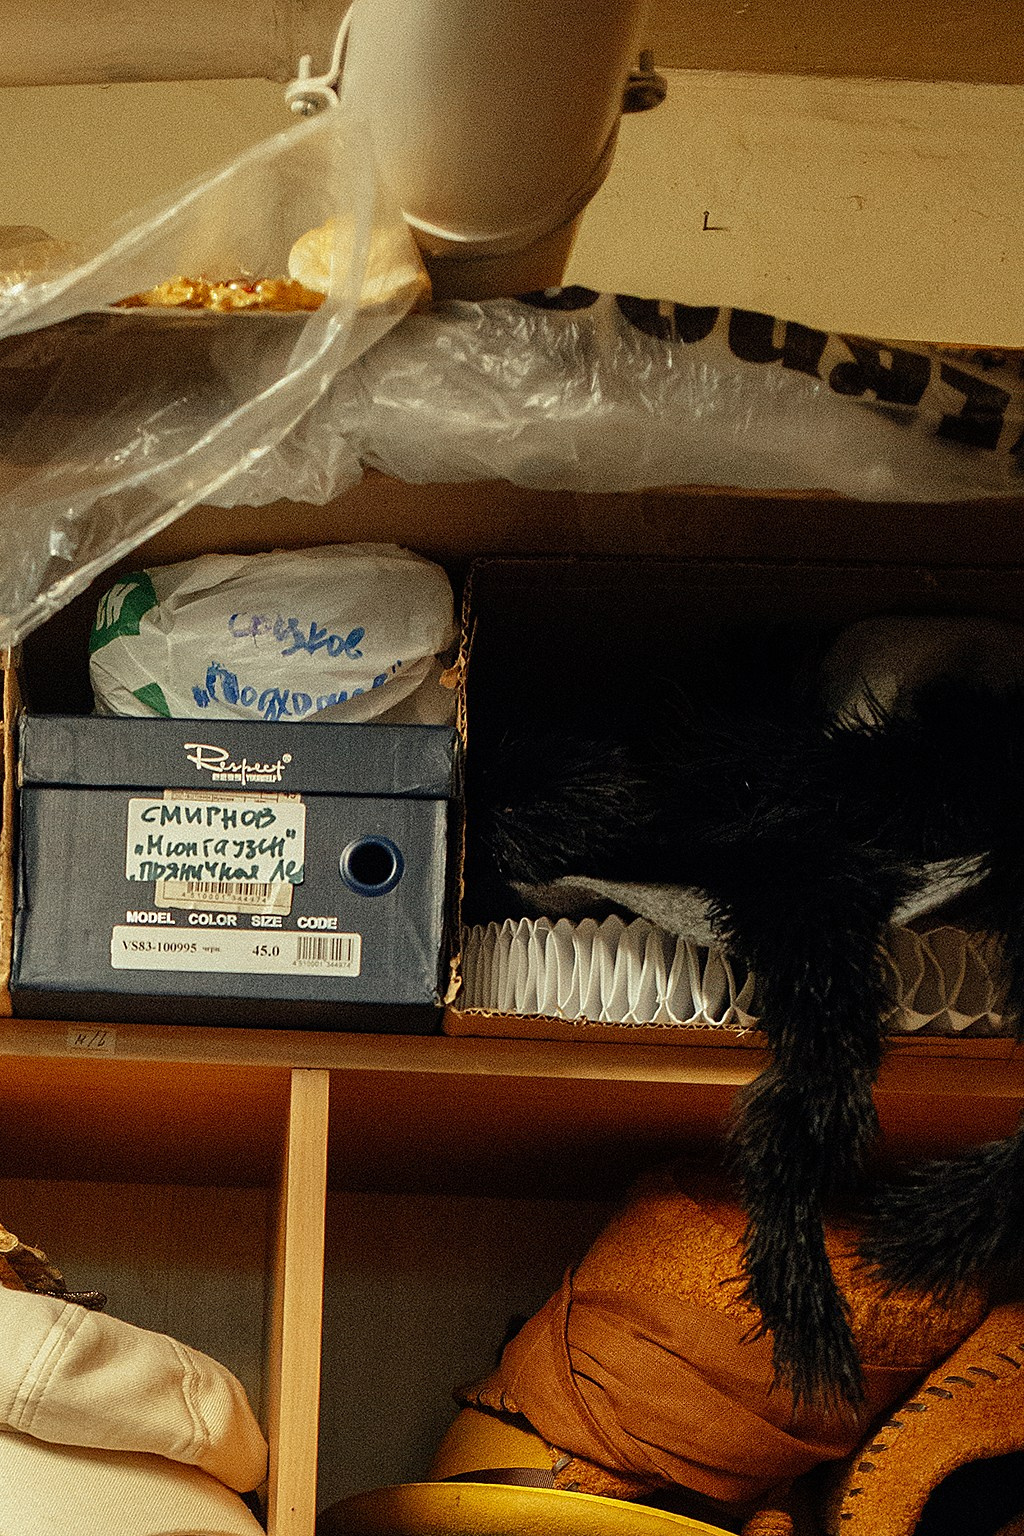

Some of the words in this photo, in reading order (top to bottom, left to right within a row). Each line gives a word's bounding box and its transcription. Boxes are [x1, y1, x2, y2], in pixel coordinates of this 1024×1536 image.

[184, 743, 285, 785] Respect
[141, 805, 276, 830] СМИРНОВ
[126, 911, 175, 924] MODEL
[188, 913, 237, 926] COLOR
[251, 916, 282, 928] SIZE
[297, 917, 338, 930] CODE
[122, 940, 197, 953] VS83-100995
[252, 945, 280, 957] 45.0
